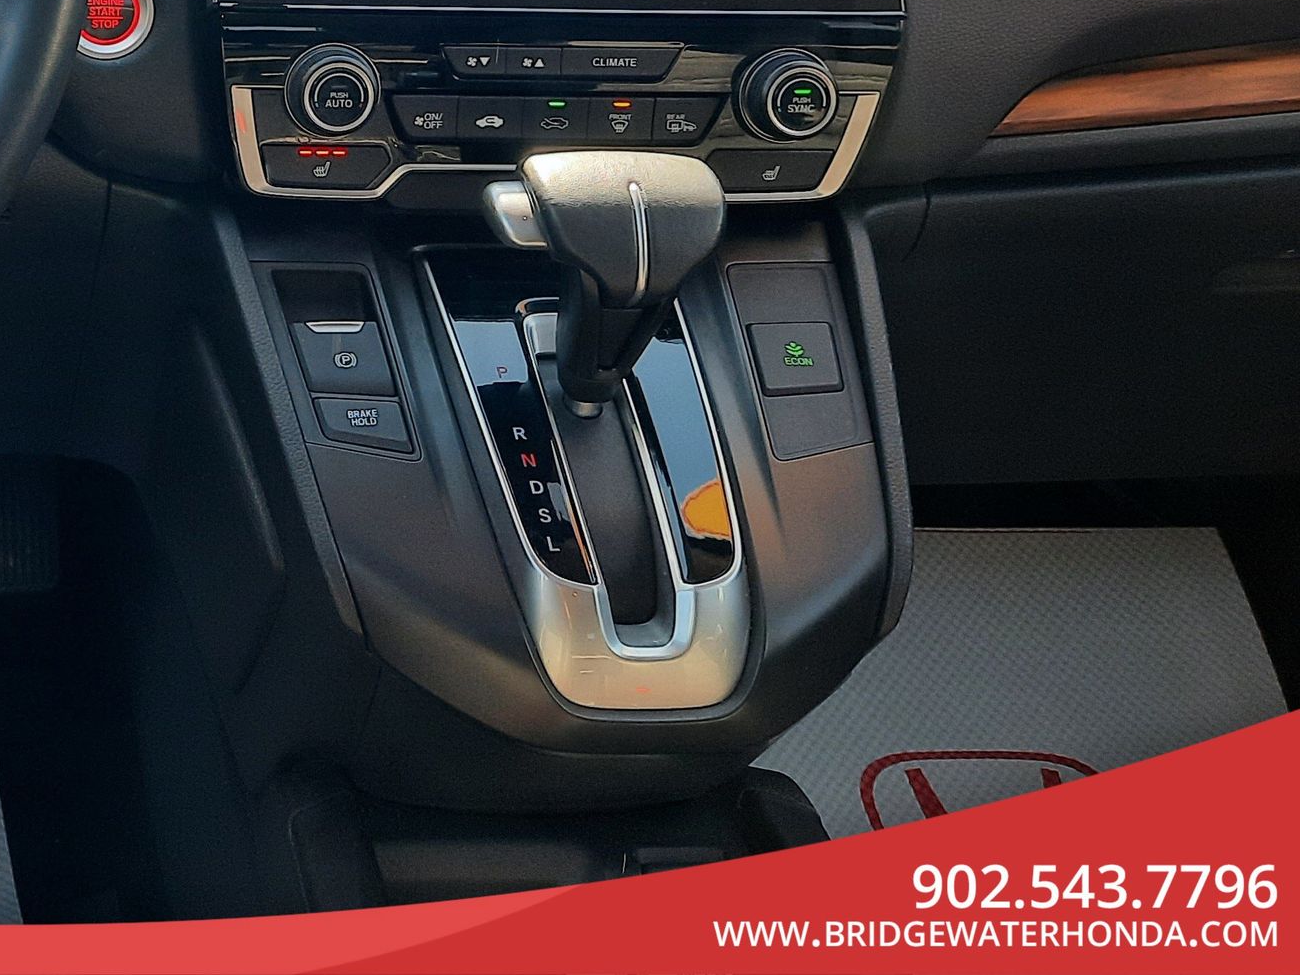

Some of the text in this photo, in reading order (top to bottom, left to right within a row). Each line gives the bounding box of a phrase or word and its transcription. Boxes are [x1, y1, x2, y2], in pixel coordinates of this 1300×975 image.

[89, 6, 121, 16] START
[91, 19, 119, 28] STOP
[592, 58, 637, 67] CLIMATE
[325, 99, 353, 108] AUTO
[787, 104, 815, 114] SYNC
[423, 121, 443, 129] OFF
[784, 357, 813, 366] ECON
[496, 366, 508, 379] P
[347, 409, 378, 419] BRAKE
[351, 418, 377, 426] HOLD
[512, 427, 527, 440] R
[520, 453, 537, 467] N
[529, 480, 544, 494] D
[538, 508, 552, 523] S
[546, 536, 560, 552] L
